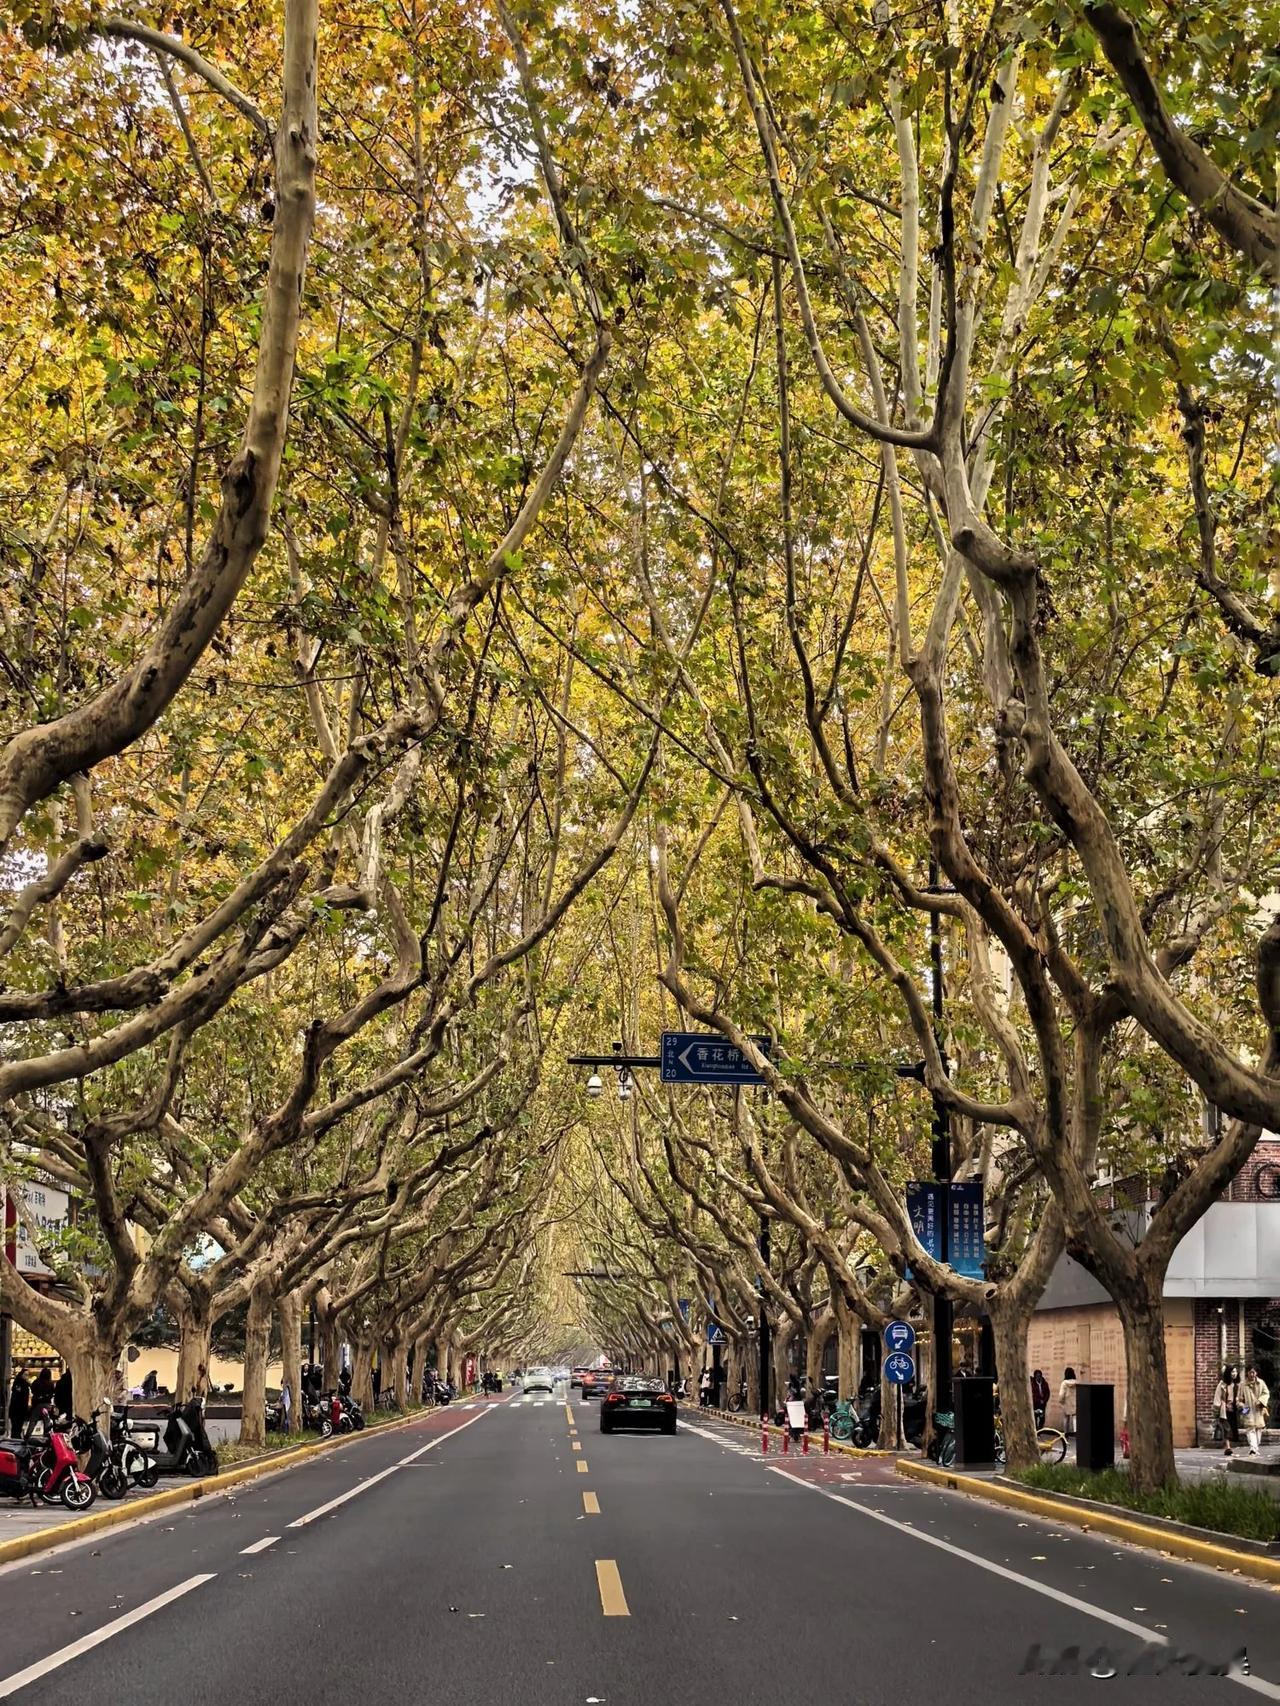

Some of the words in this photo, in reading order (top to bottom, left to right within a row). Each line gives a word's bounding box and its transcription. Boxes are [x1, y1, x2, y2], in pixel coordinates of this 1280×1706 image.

[666, 1037, 677, 1046] 29
[665, 1069, 677, 1078] 20
[913, 1205, 925, 1235] 文明
